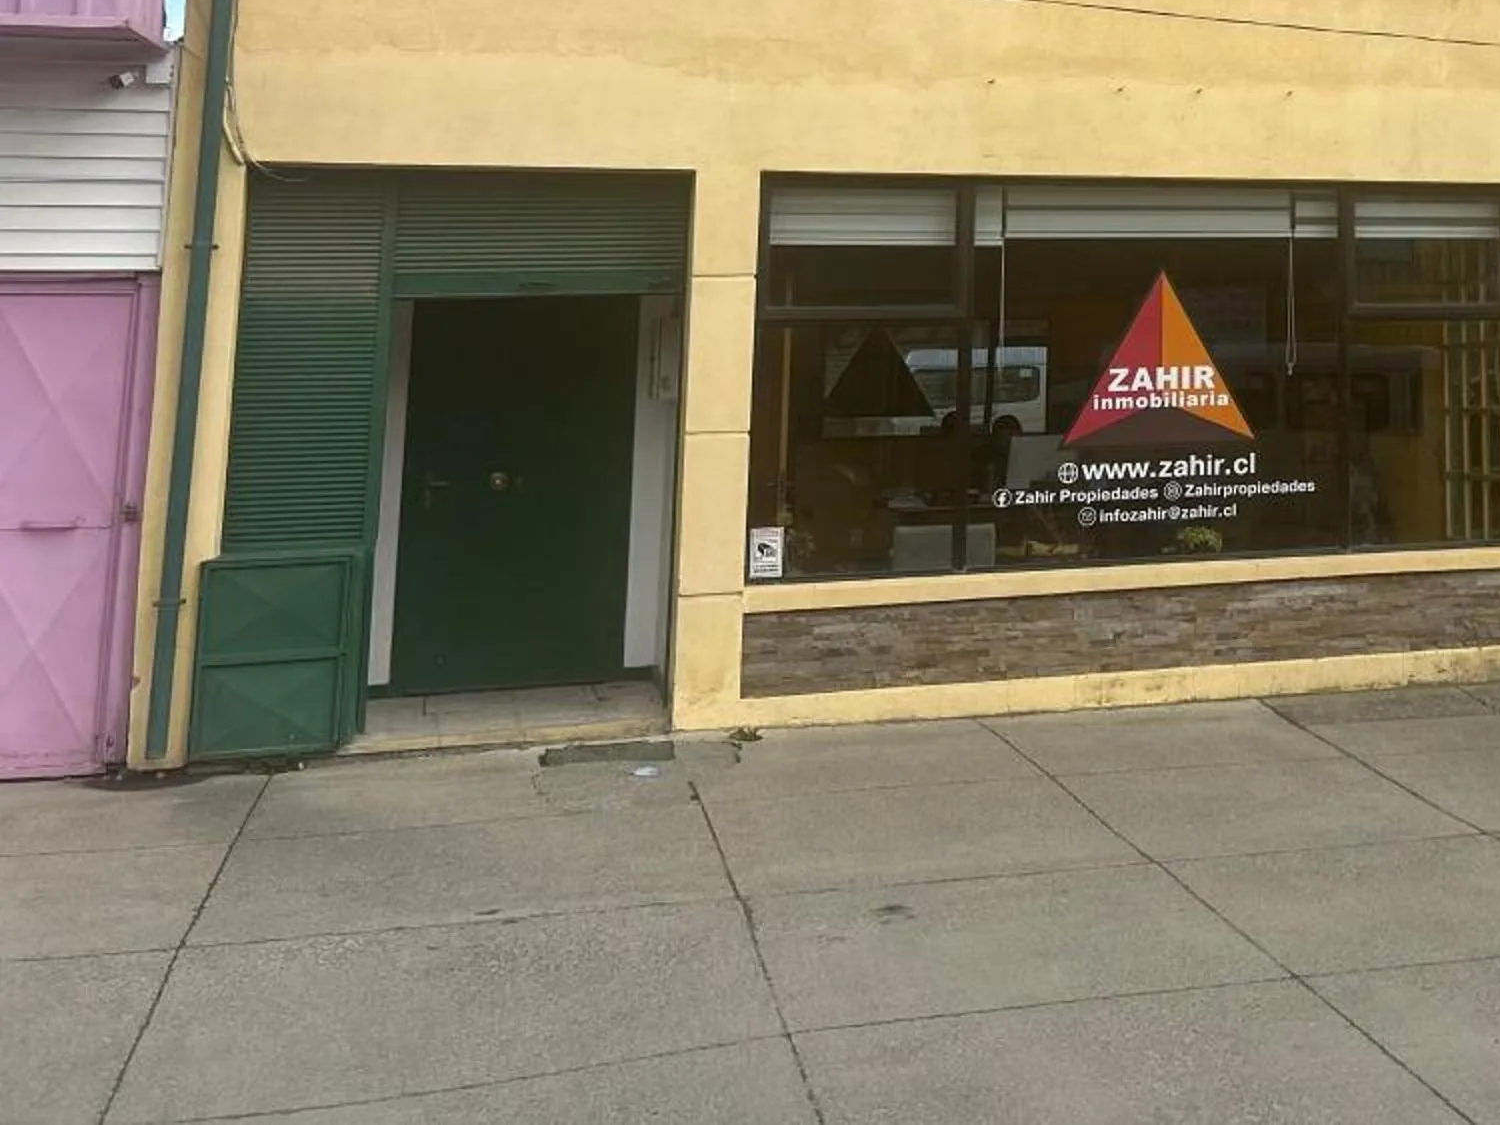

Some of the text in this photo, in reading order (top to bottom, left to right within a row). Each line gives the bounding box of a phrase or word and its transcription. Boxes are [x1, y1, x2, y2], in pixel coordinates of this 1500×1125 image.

[1107, 365, 1216, 392] ZAHIR
[1093, 390, 1230, 410] inmobiliaria
[1081, 452, 1257, 480] www.zahir.cl
[1014, 486, 1159, 505] Zahir Propiedades
[1184, 479, 1316, 498] Zahirpropiedades
[1099, 502, 1238, 523] infozahir@zahir.cl
